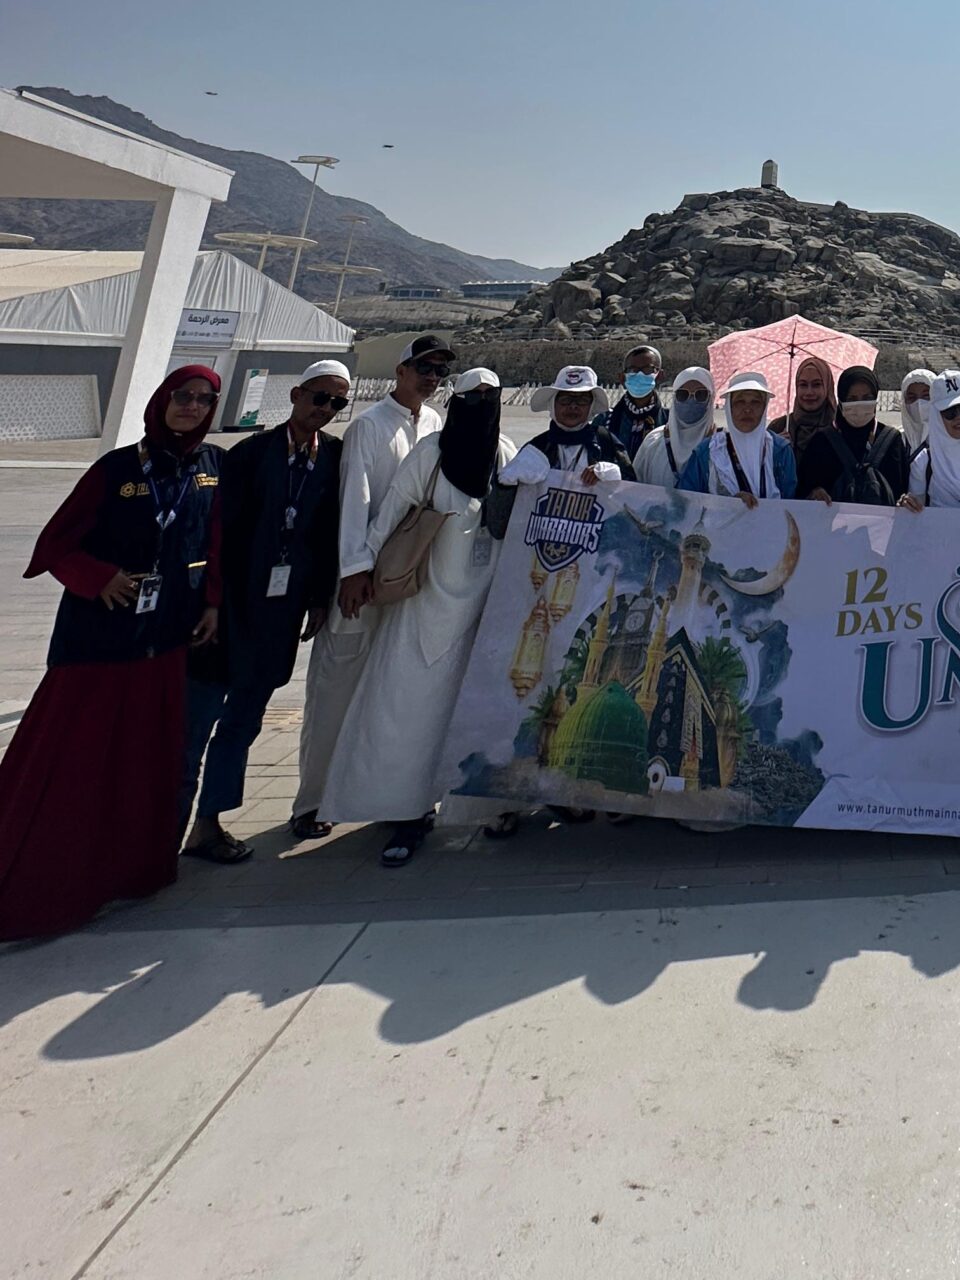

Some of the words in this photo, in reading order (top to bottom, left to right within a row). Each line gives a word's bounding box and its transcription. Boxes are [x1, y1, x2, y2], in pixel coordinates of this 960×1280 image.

[526, 515, 603, 552] WARRIORS
[843, 567, 889, 607] 12
[835, 602, 924, 637] DAYS
